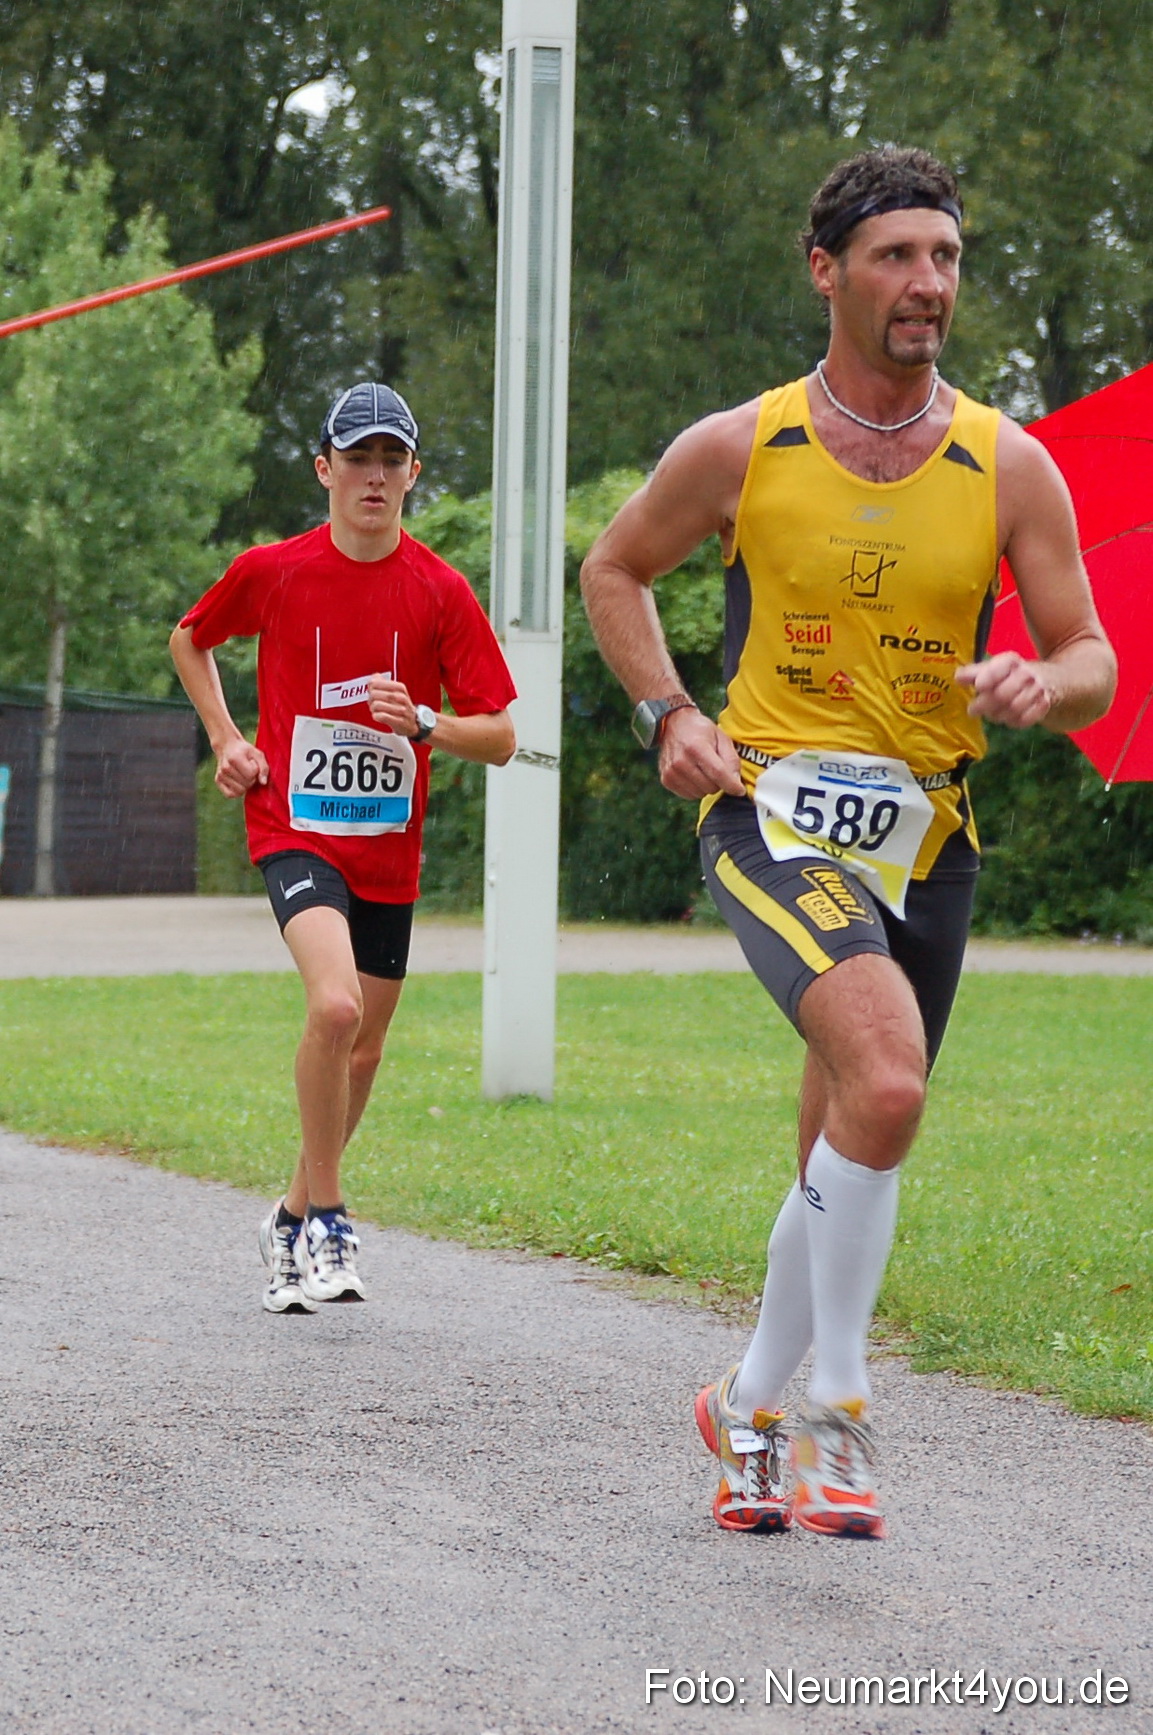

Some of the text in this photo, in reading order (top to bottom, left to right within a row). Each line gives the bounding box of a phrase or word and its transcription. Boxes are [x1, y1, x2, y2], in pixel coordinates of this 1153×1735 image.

[841, 598, 895, 614] NEUMARKT
[784, 623, 831, 644] Seidl
[880, 624, 955, 655] RÖDL
[891, 673, 950, 693] PIZZERIA
[902, 690, 942, 705] ELIO
[303, 748, 404, 793] 2665
[320, 801, 381, 819] Michael
[792, 786, 901, 852] 589
